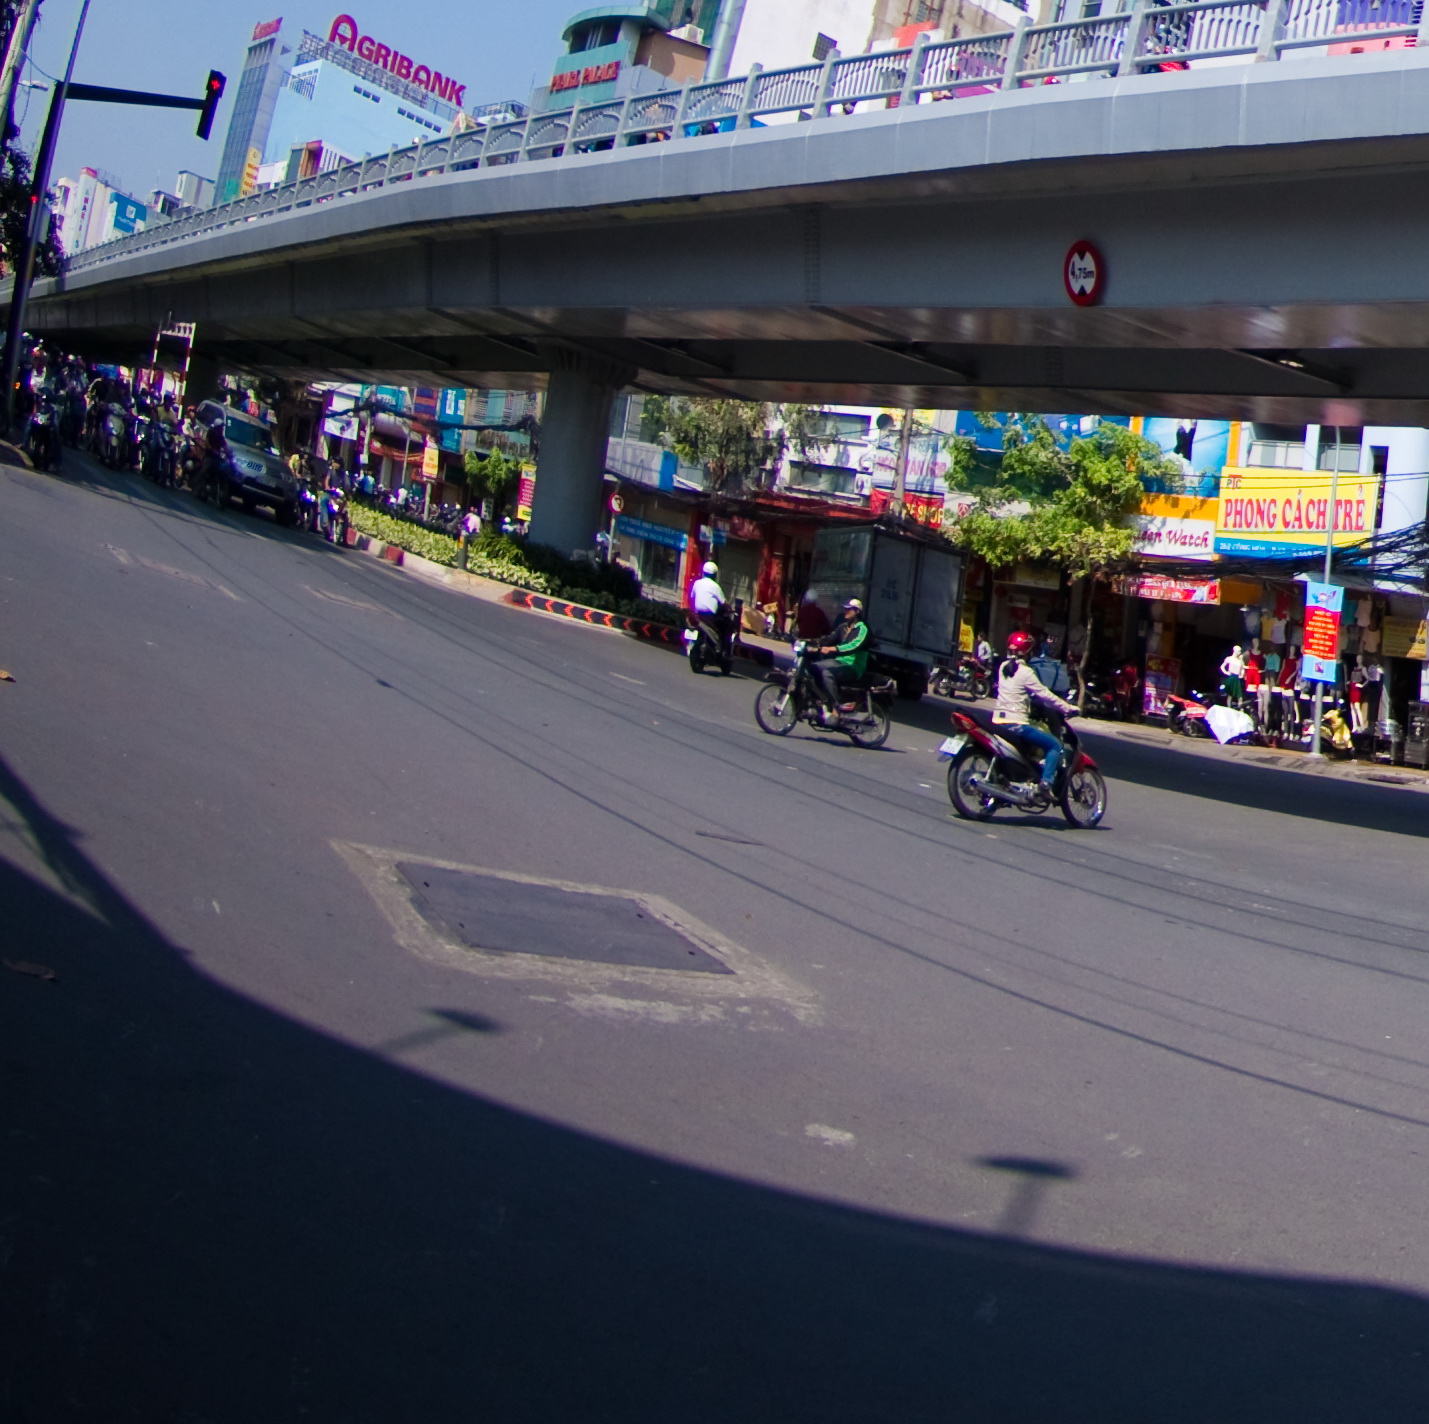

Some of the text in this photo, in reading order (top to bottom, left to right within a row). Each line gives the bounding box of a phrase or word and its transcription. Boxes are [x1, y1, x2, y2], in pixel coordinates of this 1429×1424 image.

[328, 14, 467, 107] AGRIBANK
[1223, 498, 1277, 529] PHONG
[1281, 488, 1328, 530] CÁCH
[1165, 529, 1210, 548] Watch
